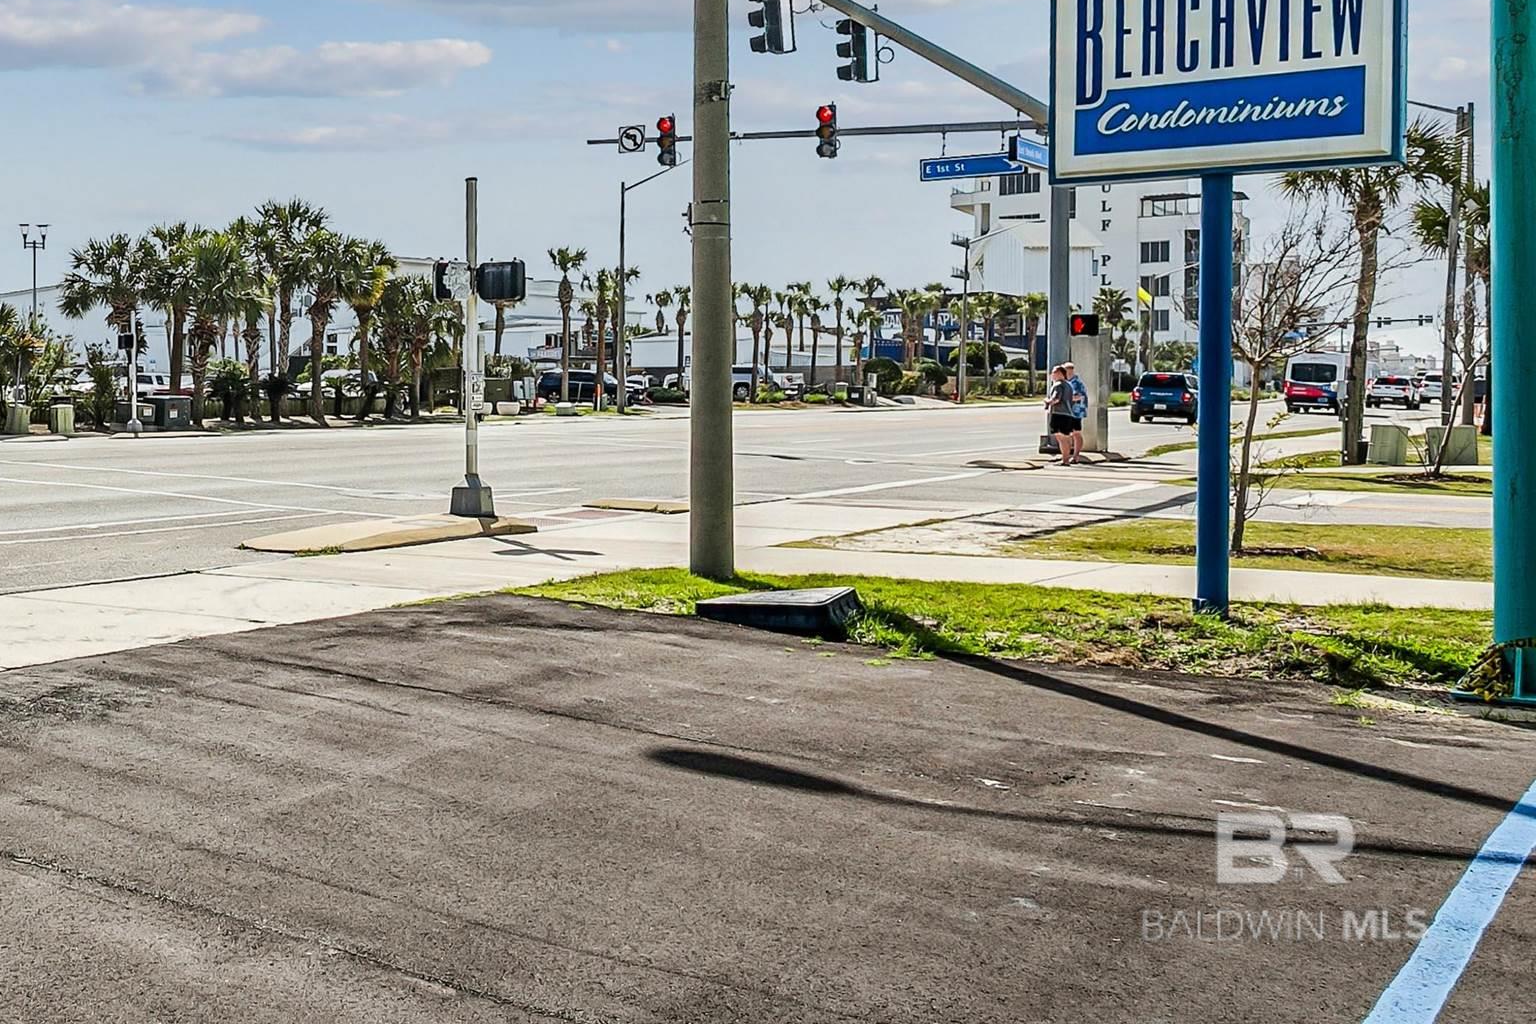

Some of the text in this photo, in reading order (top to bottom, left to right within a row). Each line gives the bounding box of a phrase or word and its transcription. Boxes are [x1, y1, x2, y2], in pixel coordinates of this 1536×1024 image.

[1097, 95, 1349, 136] Condominiums
[926, 163, 965, 174] E 1st St
